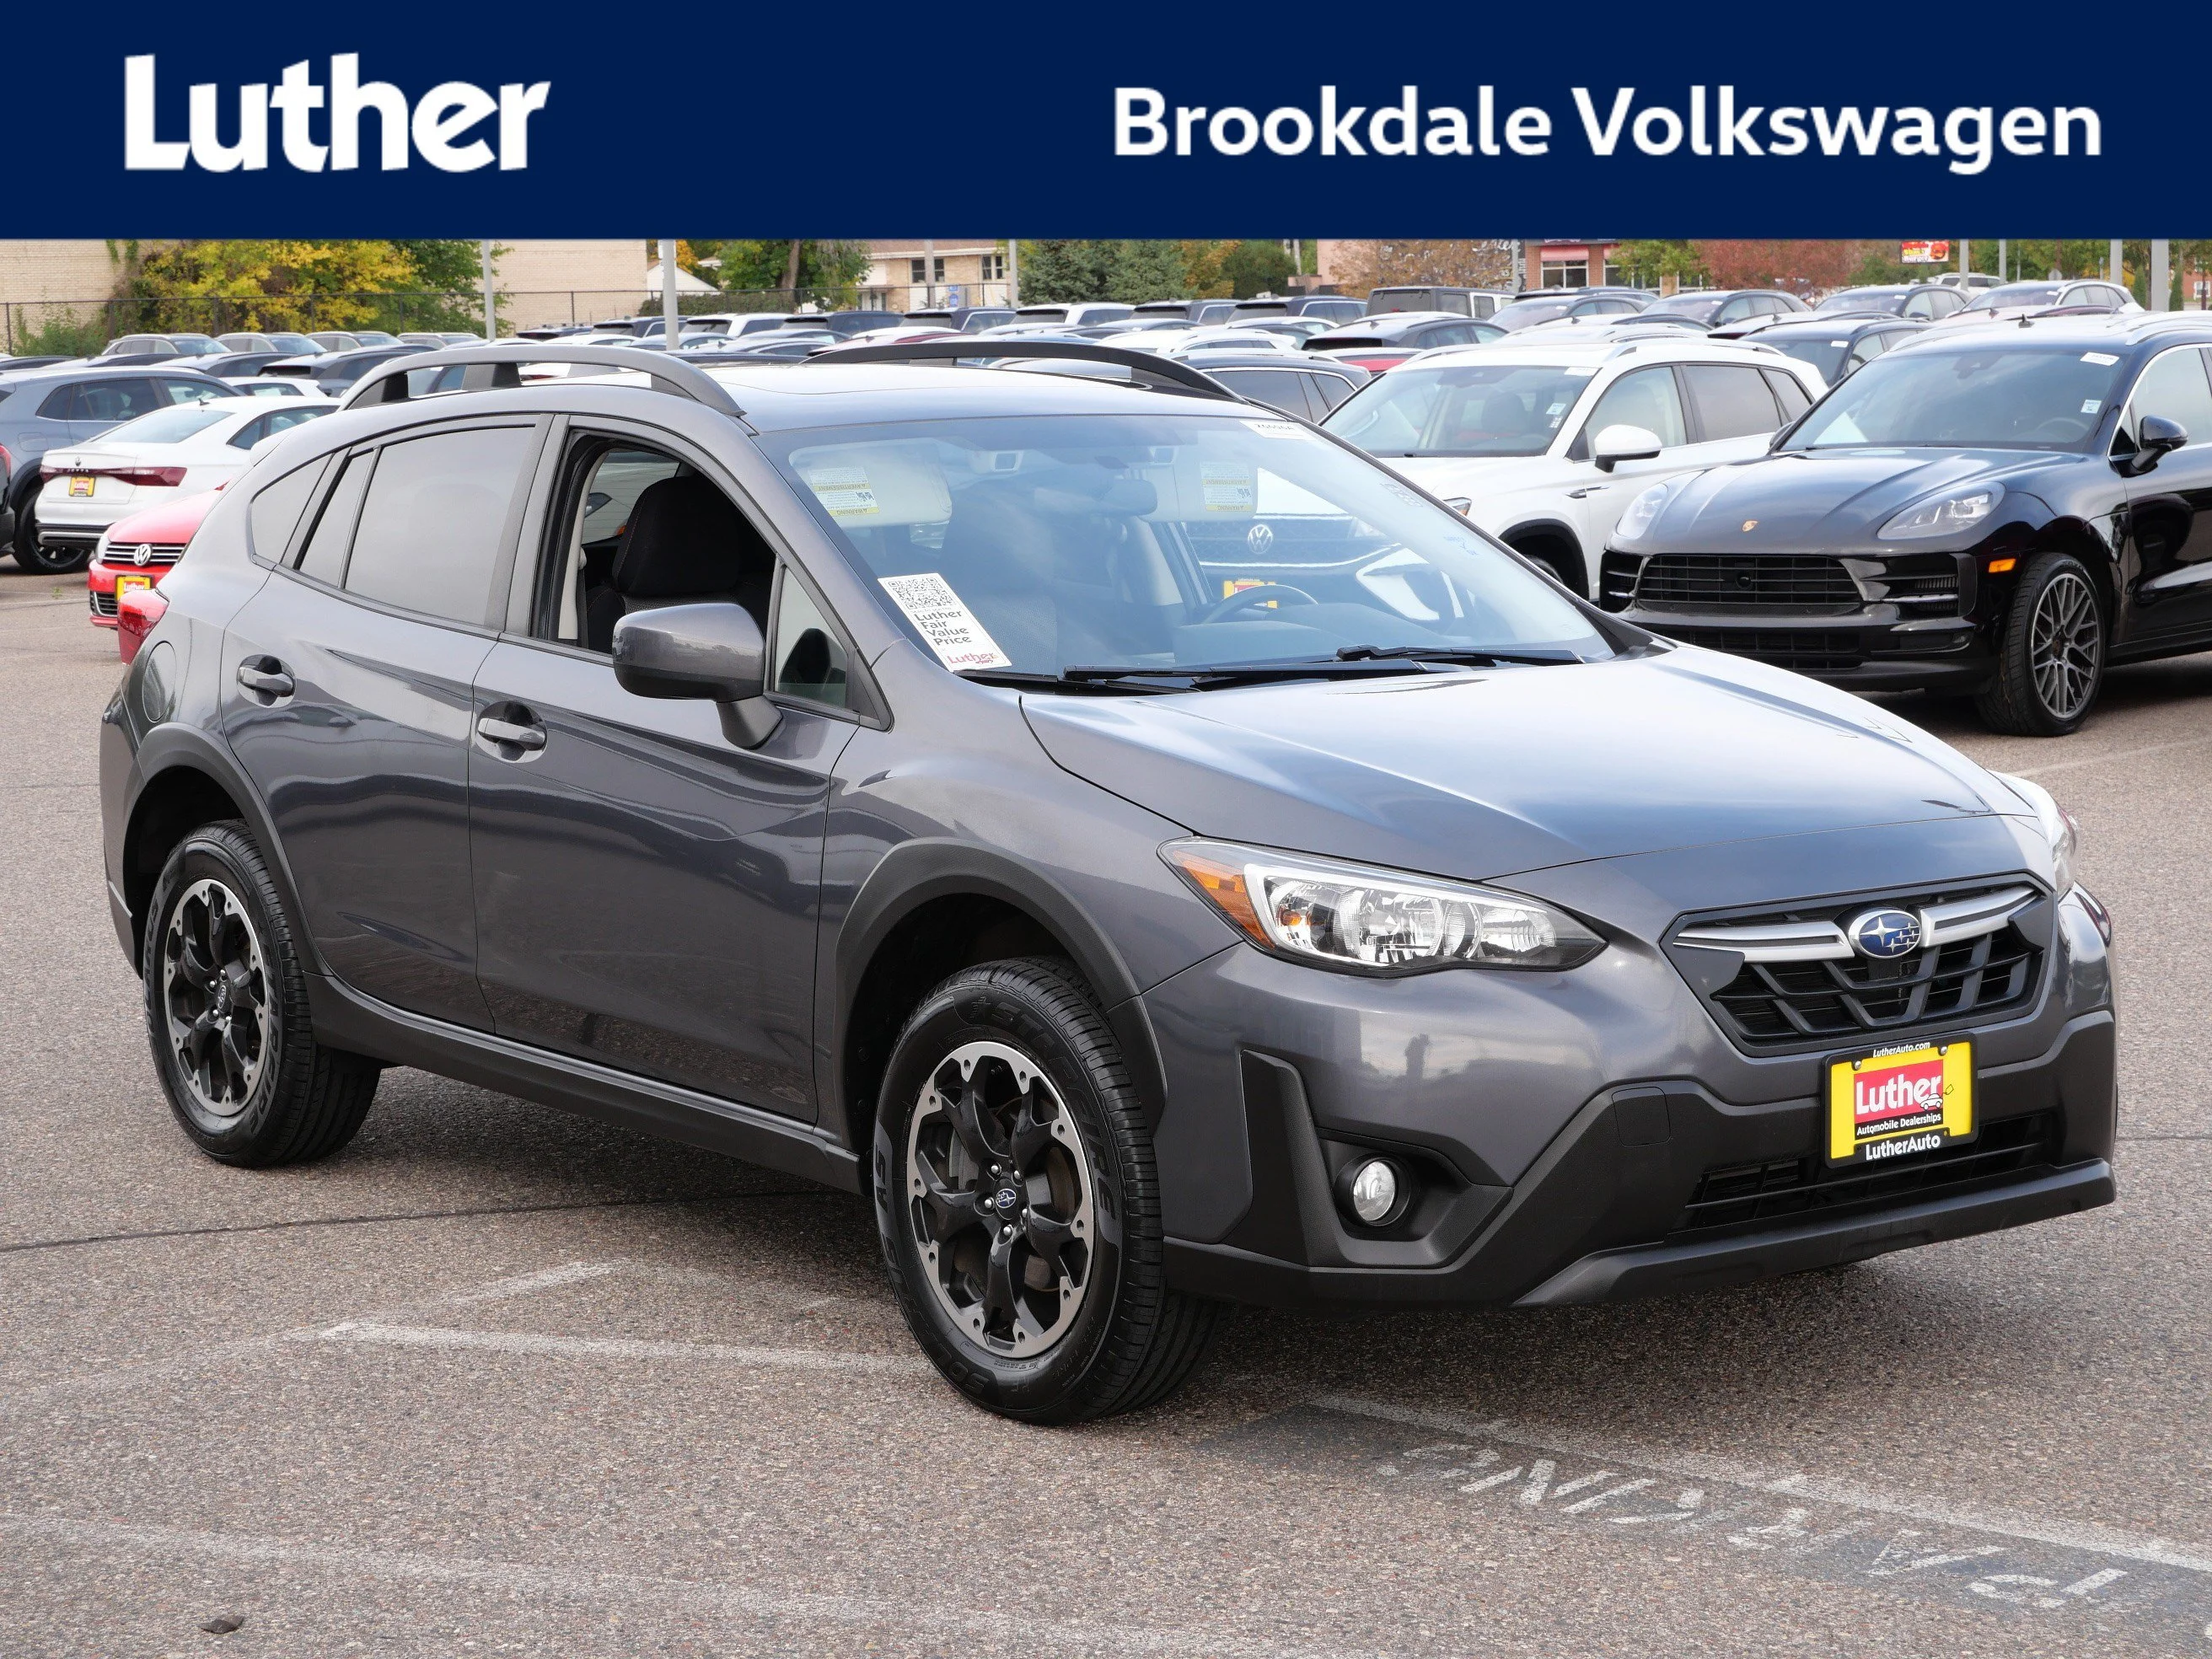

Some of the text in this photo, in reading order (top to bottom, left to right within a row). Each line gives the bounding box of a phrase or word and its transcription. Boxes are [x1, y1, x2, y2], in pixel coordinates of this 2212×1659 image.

[914, 610, 963, 621] Luther
[920, 620, 948, 629] Fair
[926, 627, 970, 637] Value
[933, 636, 973, 647] Price
[947, 652, 994, 664] Luther
[1872, 1042, 1930, 1058] LutherAuto.com
[1856, 1073, 1941, 1114] Luther
[1856, 1112, 1941, 1136] Automobile Dealerships
[1866, 1135, 1941, 1161] LutherAuto
